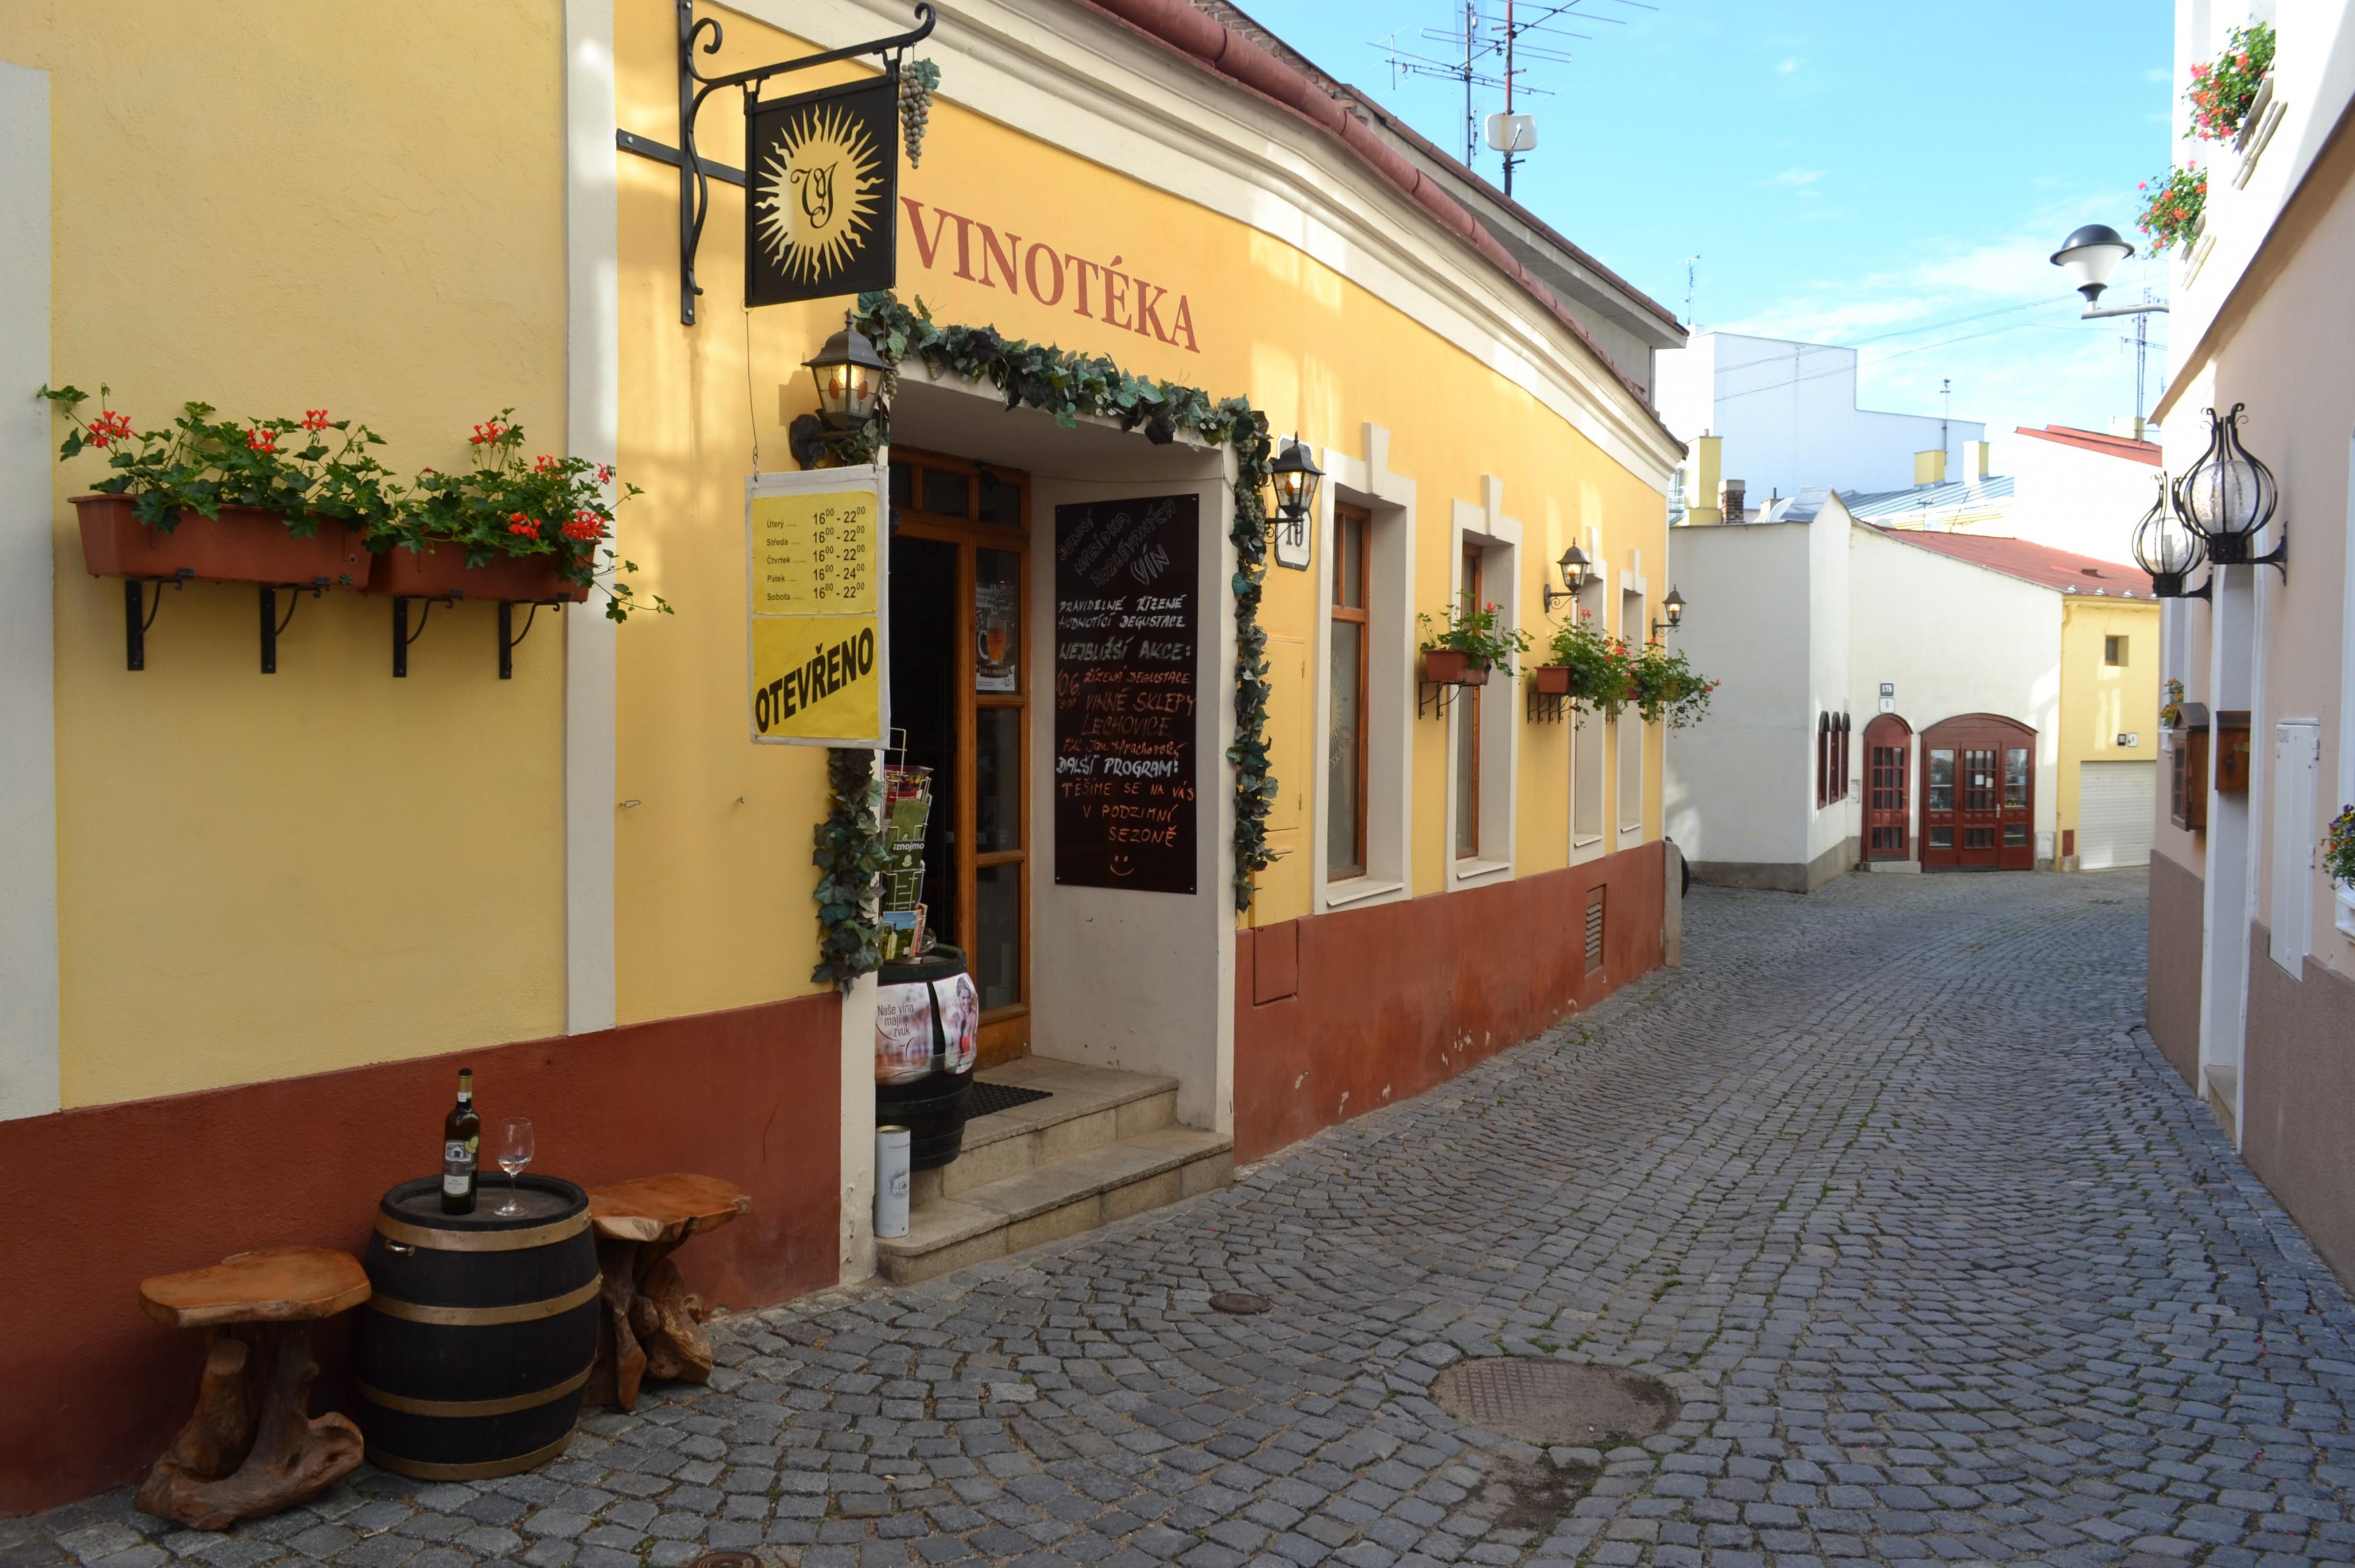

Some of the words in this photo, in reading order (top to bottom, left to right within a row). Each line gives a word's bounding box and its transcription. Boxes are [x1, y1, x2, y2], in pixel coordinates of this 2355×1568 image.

[900, 195, 1200, 354] VINOTÉKA
[767, 518, 784, 529] Úterý
[767, 538, 788, 546] Středa
[767, 554, 791, 564] Čtvrtek
[1130, 543, 1170, 585] VÍN
[767, 593, 790, 601] Sobota
[1059, 596, 1127, 613] PRAVIDELNÉ
[1119, 614, 1186, 631] DEGUSTACE
[1138, 639, 1192, 661] AKCE:
[755, 627, 874, 733] OTEVŘENO
[1126, 671, 1192, 685] DEGUSTACE
[1086, 687, 1132, 712] VINNÉ
[1133, 692, 1196, 716] SKLEPY
[1081, 713, 1172, 738] LECHOVICE
[1056, 754, 1101, 775] DALŠÍ
[1103, 757, 1179, 778] PROGRAM:
[1060, 776, 1113, 799] TĚŠÍME
[1123, 782, 1142, 795] SE
[1150, 783, 1165, 795] NA
[1083, 805, 1092, 819] V
[1102, 803, 1179, 822] PODZIMNÍ
[1108, 825, 1178, 848] SEZONĚ
[877, 1005, 896, 1017] Naše
[898, 1003, 914, 1014] vína
[884, 1015, 901, 1028] mají
[893, 1025, 910, 1037] zvuk
